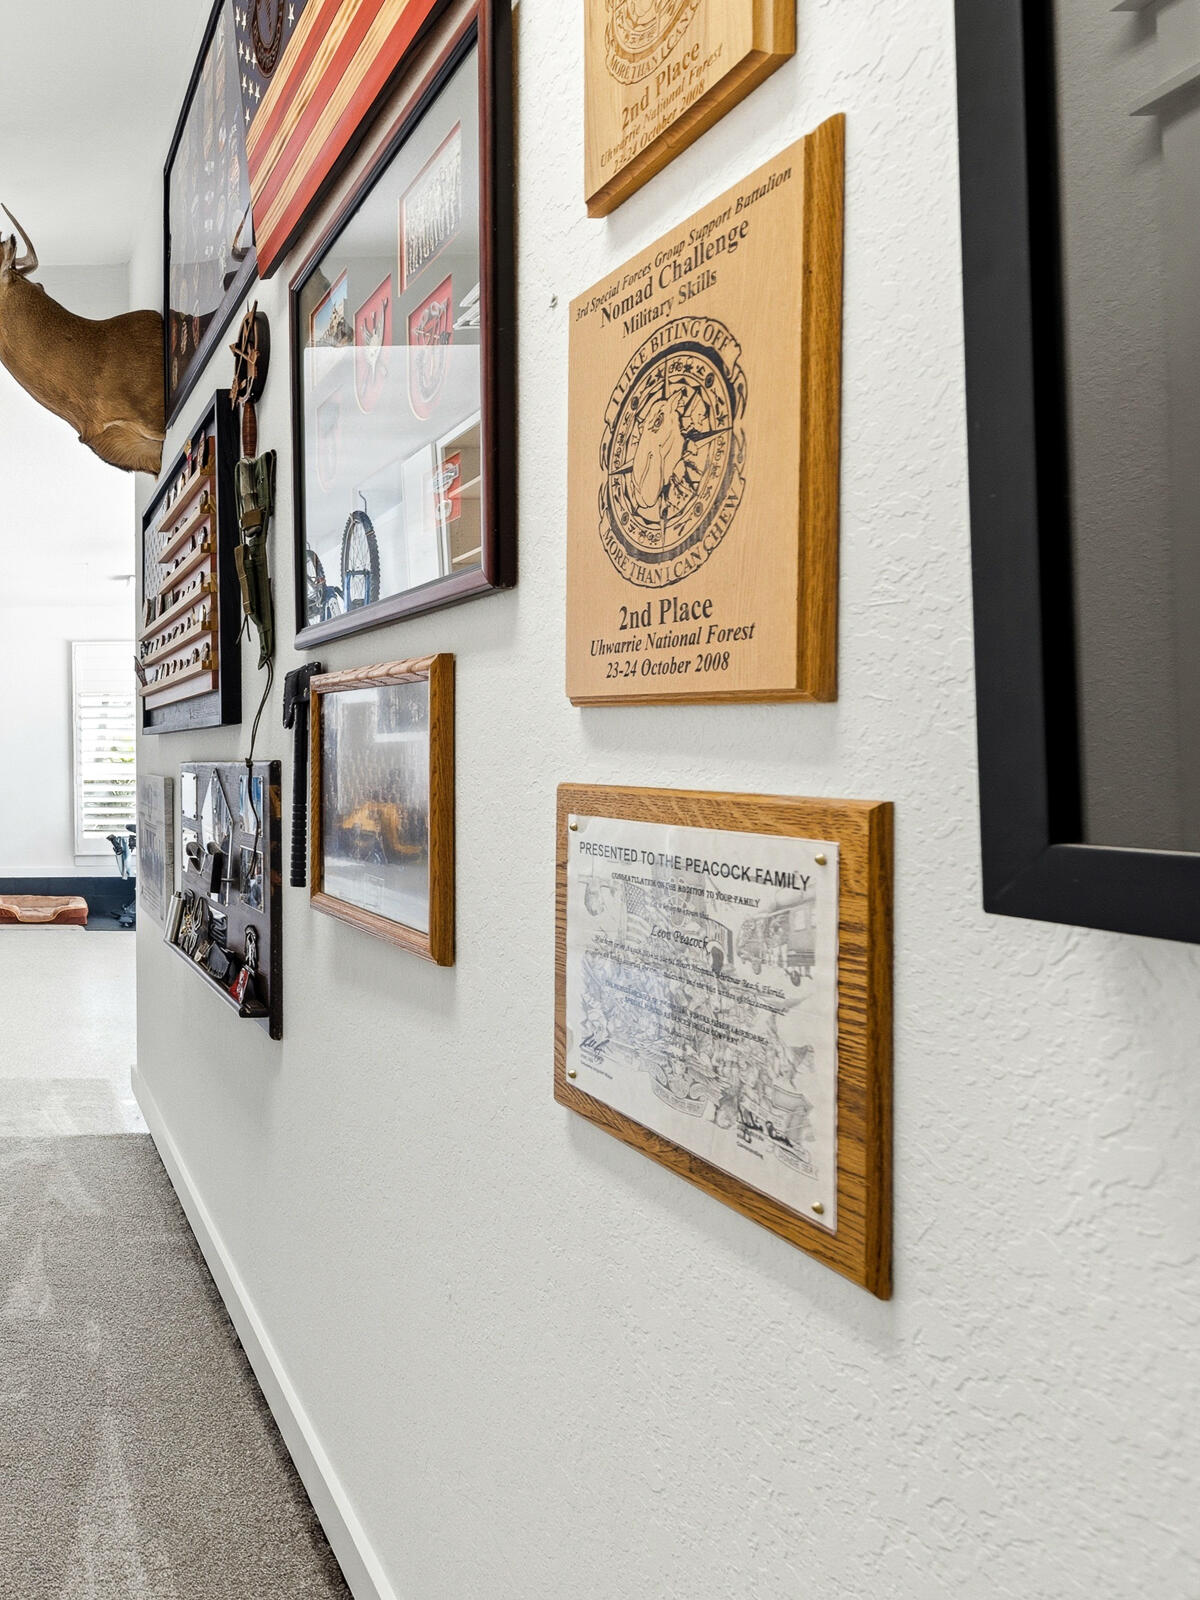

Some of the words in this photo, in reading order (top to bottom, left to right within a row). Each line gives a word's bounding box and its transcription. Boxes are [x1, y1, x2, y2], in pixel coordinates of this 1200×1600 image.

[622, 86, 649, 131] 2nd
[655, 42, 700, 98] Place
[688, 43, 723, 86] Forest
[576, 302, 589, 322] 3rd
[590, 280, 620, 314] Special
[622, 261, 652, 287] Forces
[654, 240, 685, 267] Group
[688, 207, 732, 246] Support
[734, 165, 793, 216] Battalion
[600, 276, 653, 329] Nomad
[658, 219, 749, 290] Challenge
[622, 294, 675, 339] Military
[678, 267, 718, 306] Skills
[616, 351, 647, 394] LIKE
[650, 322, 701, 354] BITING
[703, 323, 732, 351] OFF
[603, 527, 628, 571] MORE
[630, 563, 664, 584] THAN
[672, 548, 704, 578] CAN
[702, 491, 739, 554] CHEW
[590, 635, 642, 657] Uhwarrie
[645, 626, 702, 651] National
[706, 622, 756, 644] Forest
[619, 602, 652, 631] 2nd
[659, 596, 713, 625] Place
[606, 660, 638, 679] 23-24
[641, 656, 692, 677] October
[695, 651, 730, 673] 2008
[579, 841, 638, 863] PRESENTED
[641, 850, 655, 866] TO
[658, 853, 682, 870] THE
[685, 857, 751, 882] PEACOCK
[755, 868, 810, 891] FAMILY
